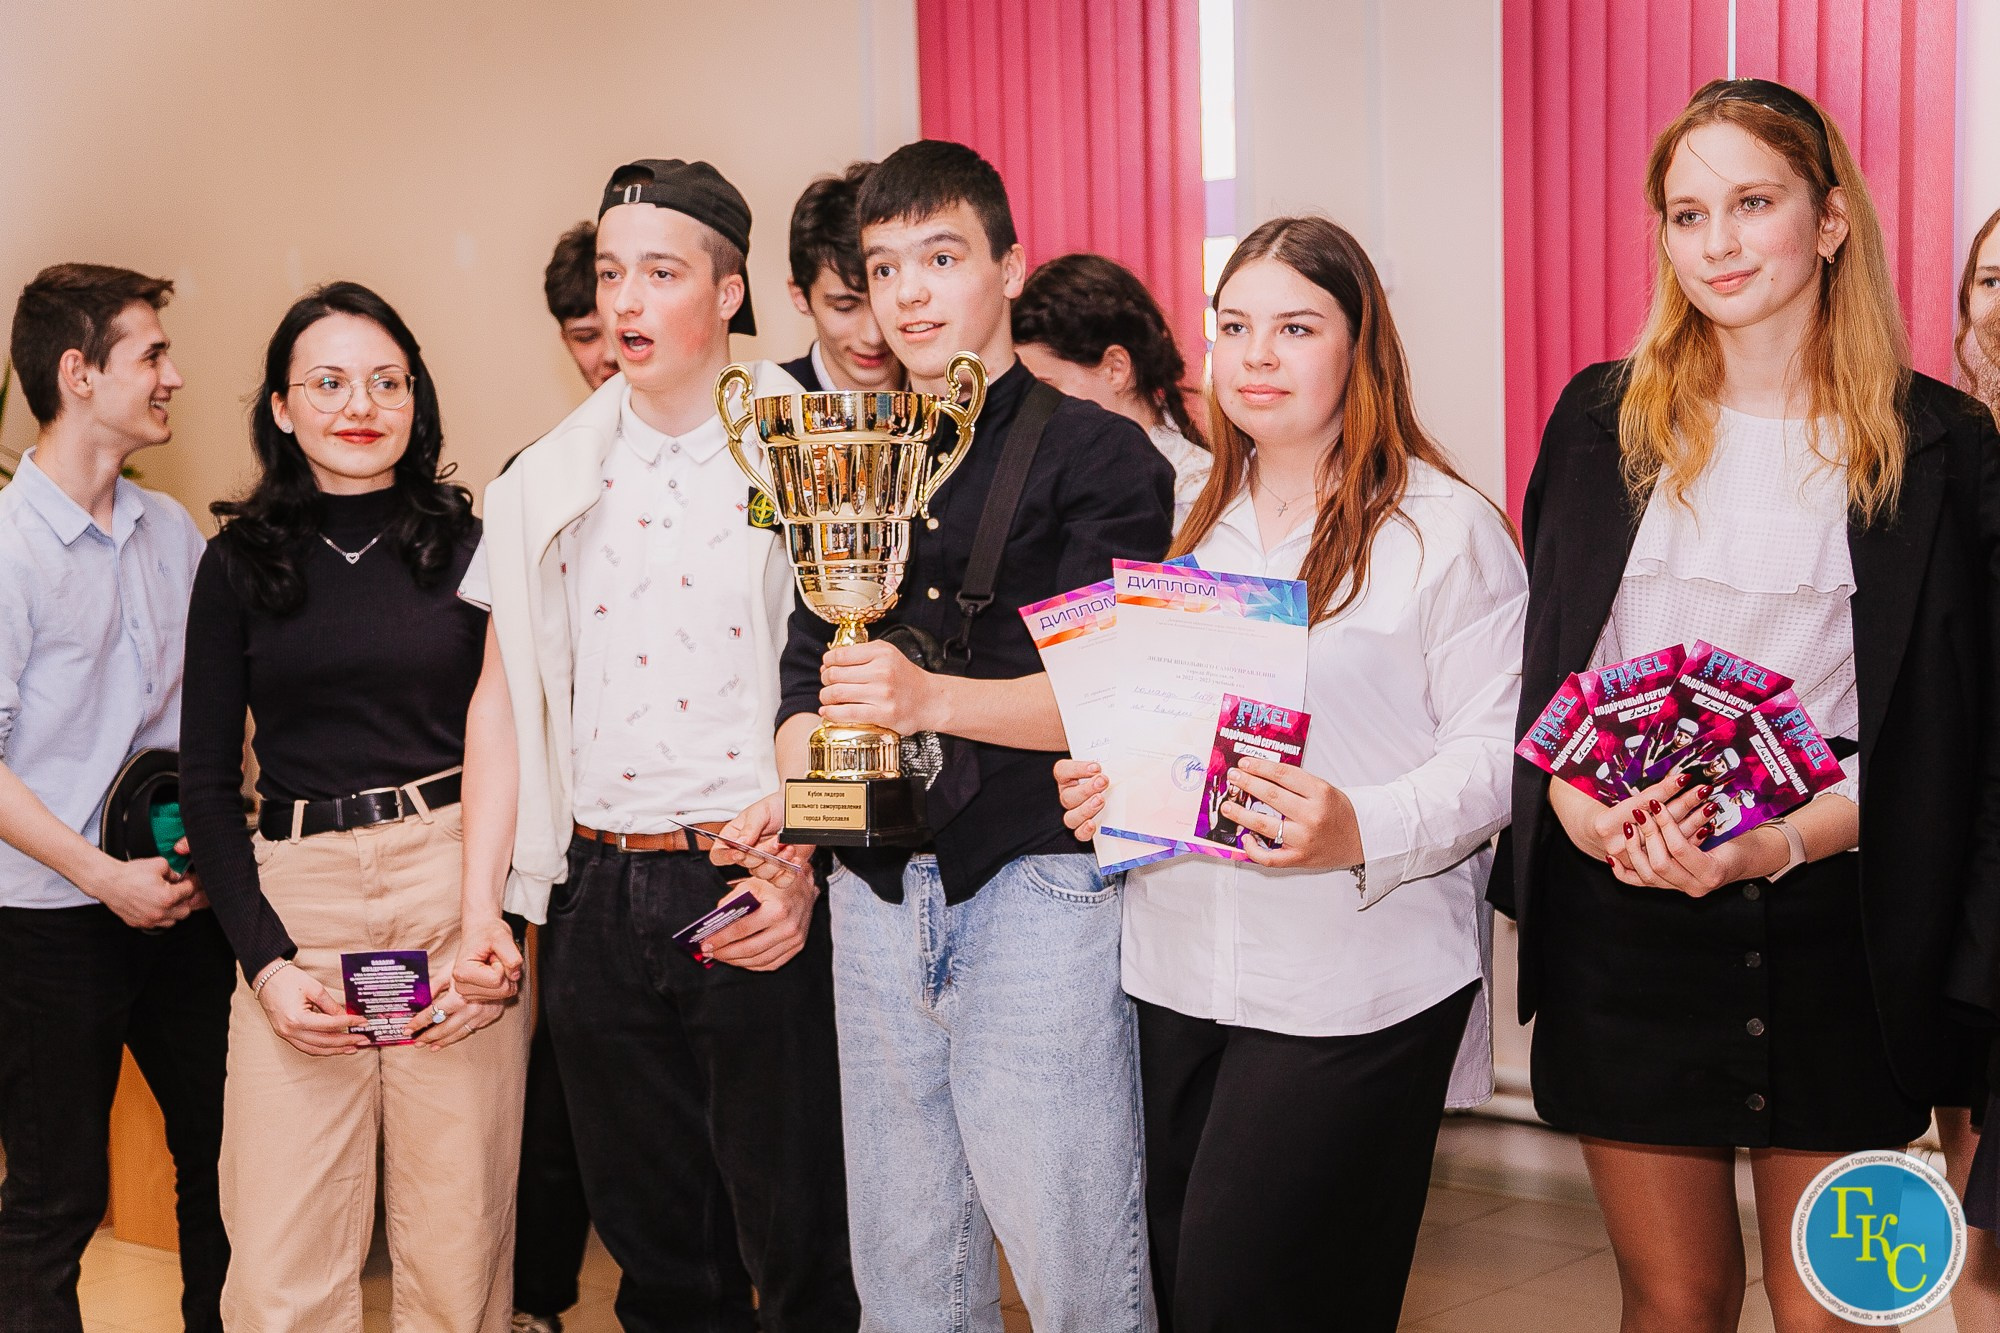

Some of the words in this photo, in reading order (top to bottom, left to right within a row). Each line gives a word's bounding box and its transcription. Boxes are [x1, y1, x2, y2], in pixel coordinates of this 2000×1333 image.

[1127, 575, 1217, 598] ДИПЛОМ
[1600, 656, 1668, 690] PIXEL
[1708, 651, 1768, 690] PIXEL
[1594, 693, 1645, 717] ПОДАРОЧНЫЙ
[1644, 685, 1671, 702] СЕРТИФ
[1679, 674, 1728, 701] ПОДАРОЧНЫЙ
[1726, 694, 1755, 712] СЕРТИФ
[1237, 700, 1292, 728] PIXEL
[1530, 695, 1578, 747] PIXEL
[1220, 727, 1261, 746] ПОДАРОЧНЫЙ
[1261, 738, 1301, 756] СЕРТИФИКАТ
[1550, 731, 1584, 771] ПОДАРОЧНЫЙ
[1578, 714, 1594, 735] СЕРТ
[1750, 711, 1785, 757] ПОДАРОЧНЫЙ
[1778, 753, 1809, 795] СЕРТИФИКАТ
[1784, 708, 1829, 770] PIXEL
